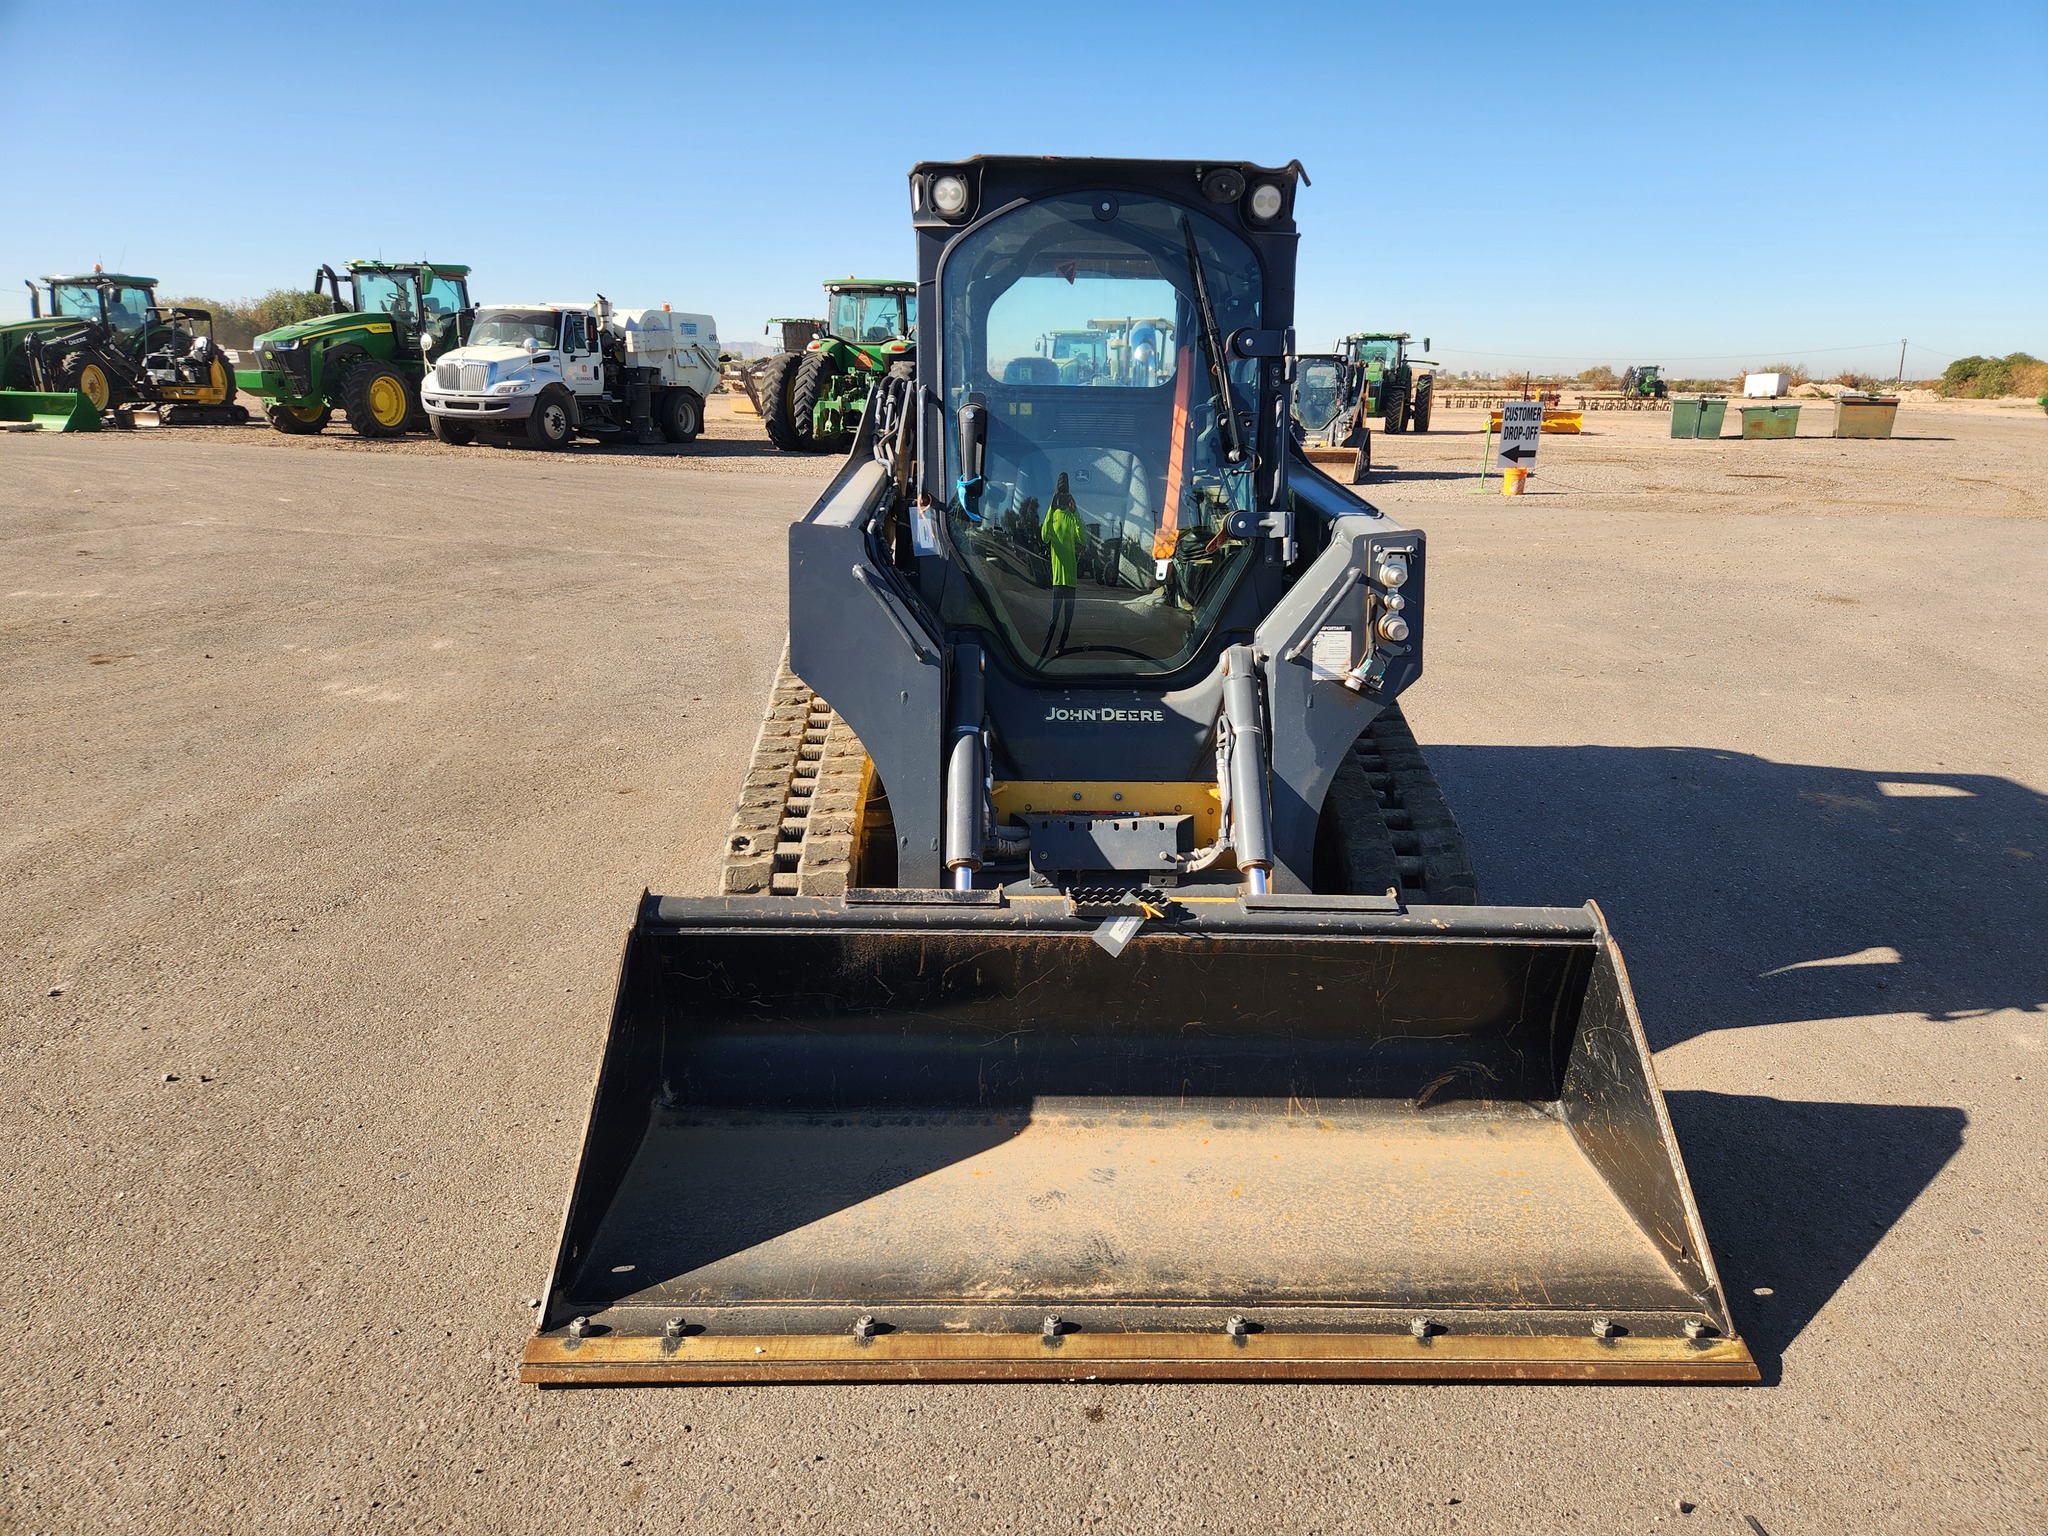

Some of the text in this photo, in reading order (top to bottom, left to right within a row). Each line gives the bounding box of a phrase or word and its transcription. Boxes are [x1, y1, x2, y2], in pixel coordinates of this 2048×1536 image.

[68, 336, 87, 346] DEERE
[1504, 406, 1542, 422] CUSTOMER
[1503, 425, 1539, 441] DROP-OFF
[1045, 707, 1164, 722] JOHN DEERE
